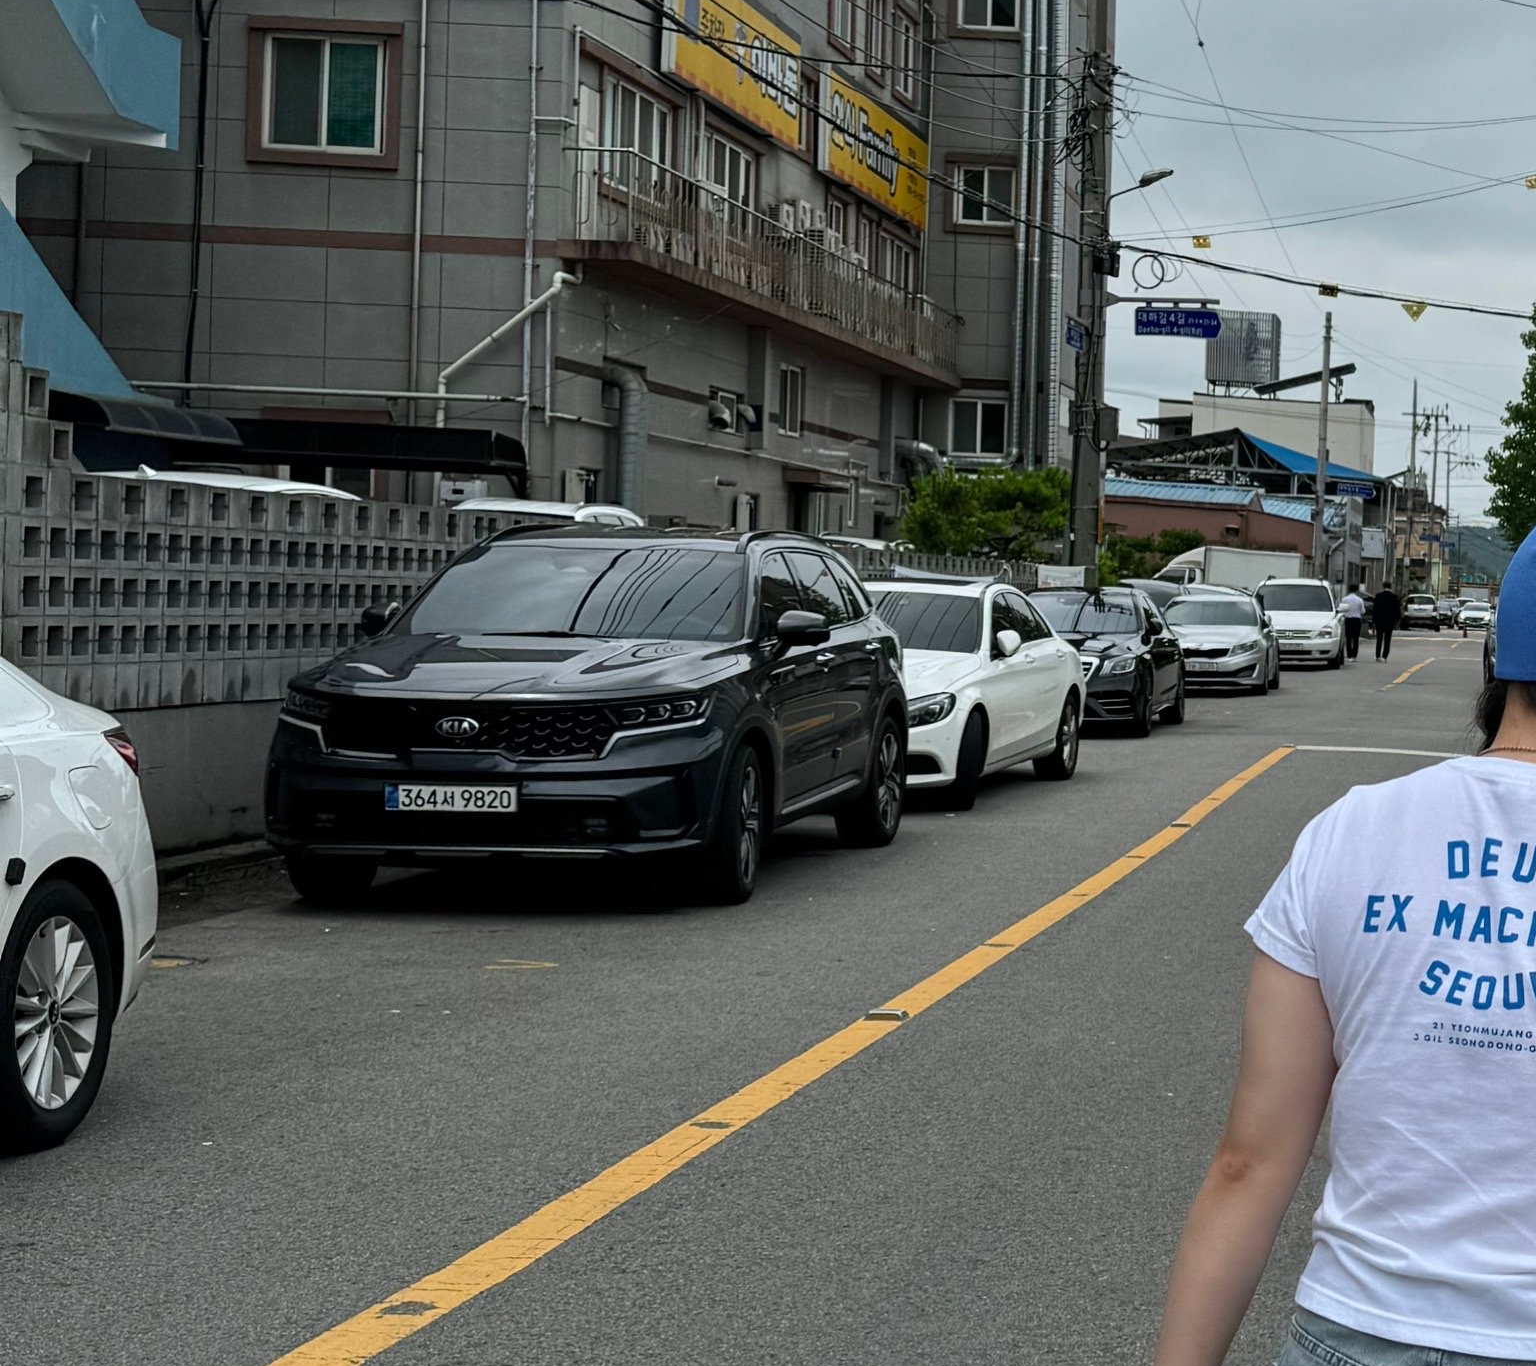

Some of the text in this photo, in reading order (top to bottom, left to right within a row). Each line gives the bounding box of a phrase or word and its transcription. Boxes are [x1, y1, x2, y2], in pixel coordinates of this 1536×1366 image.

[856, 106, 900, 196] Family
[442, 721, 470, 733] KIA
[401, 788, 512, 809] 364서 9820
[1362, 893, 1414, 934] EX
[1423, 1033, 1443, 1044] GIL
[1432, 1021, 1533, 1039] 21 YEONMUJANG
